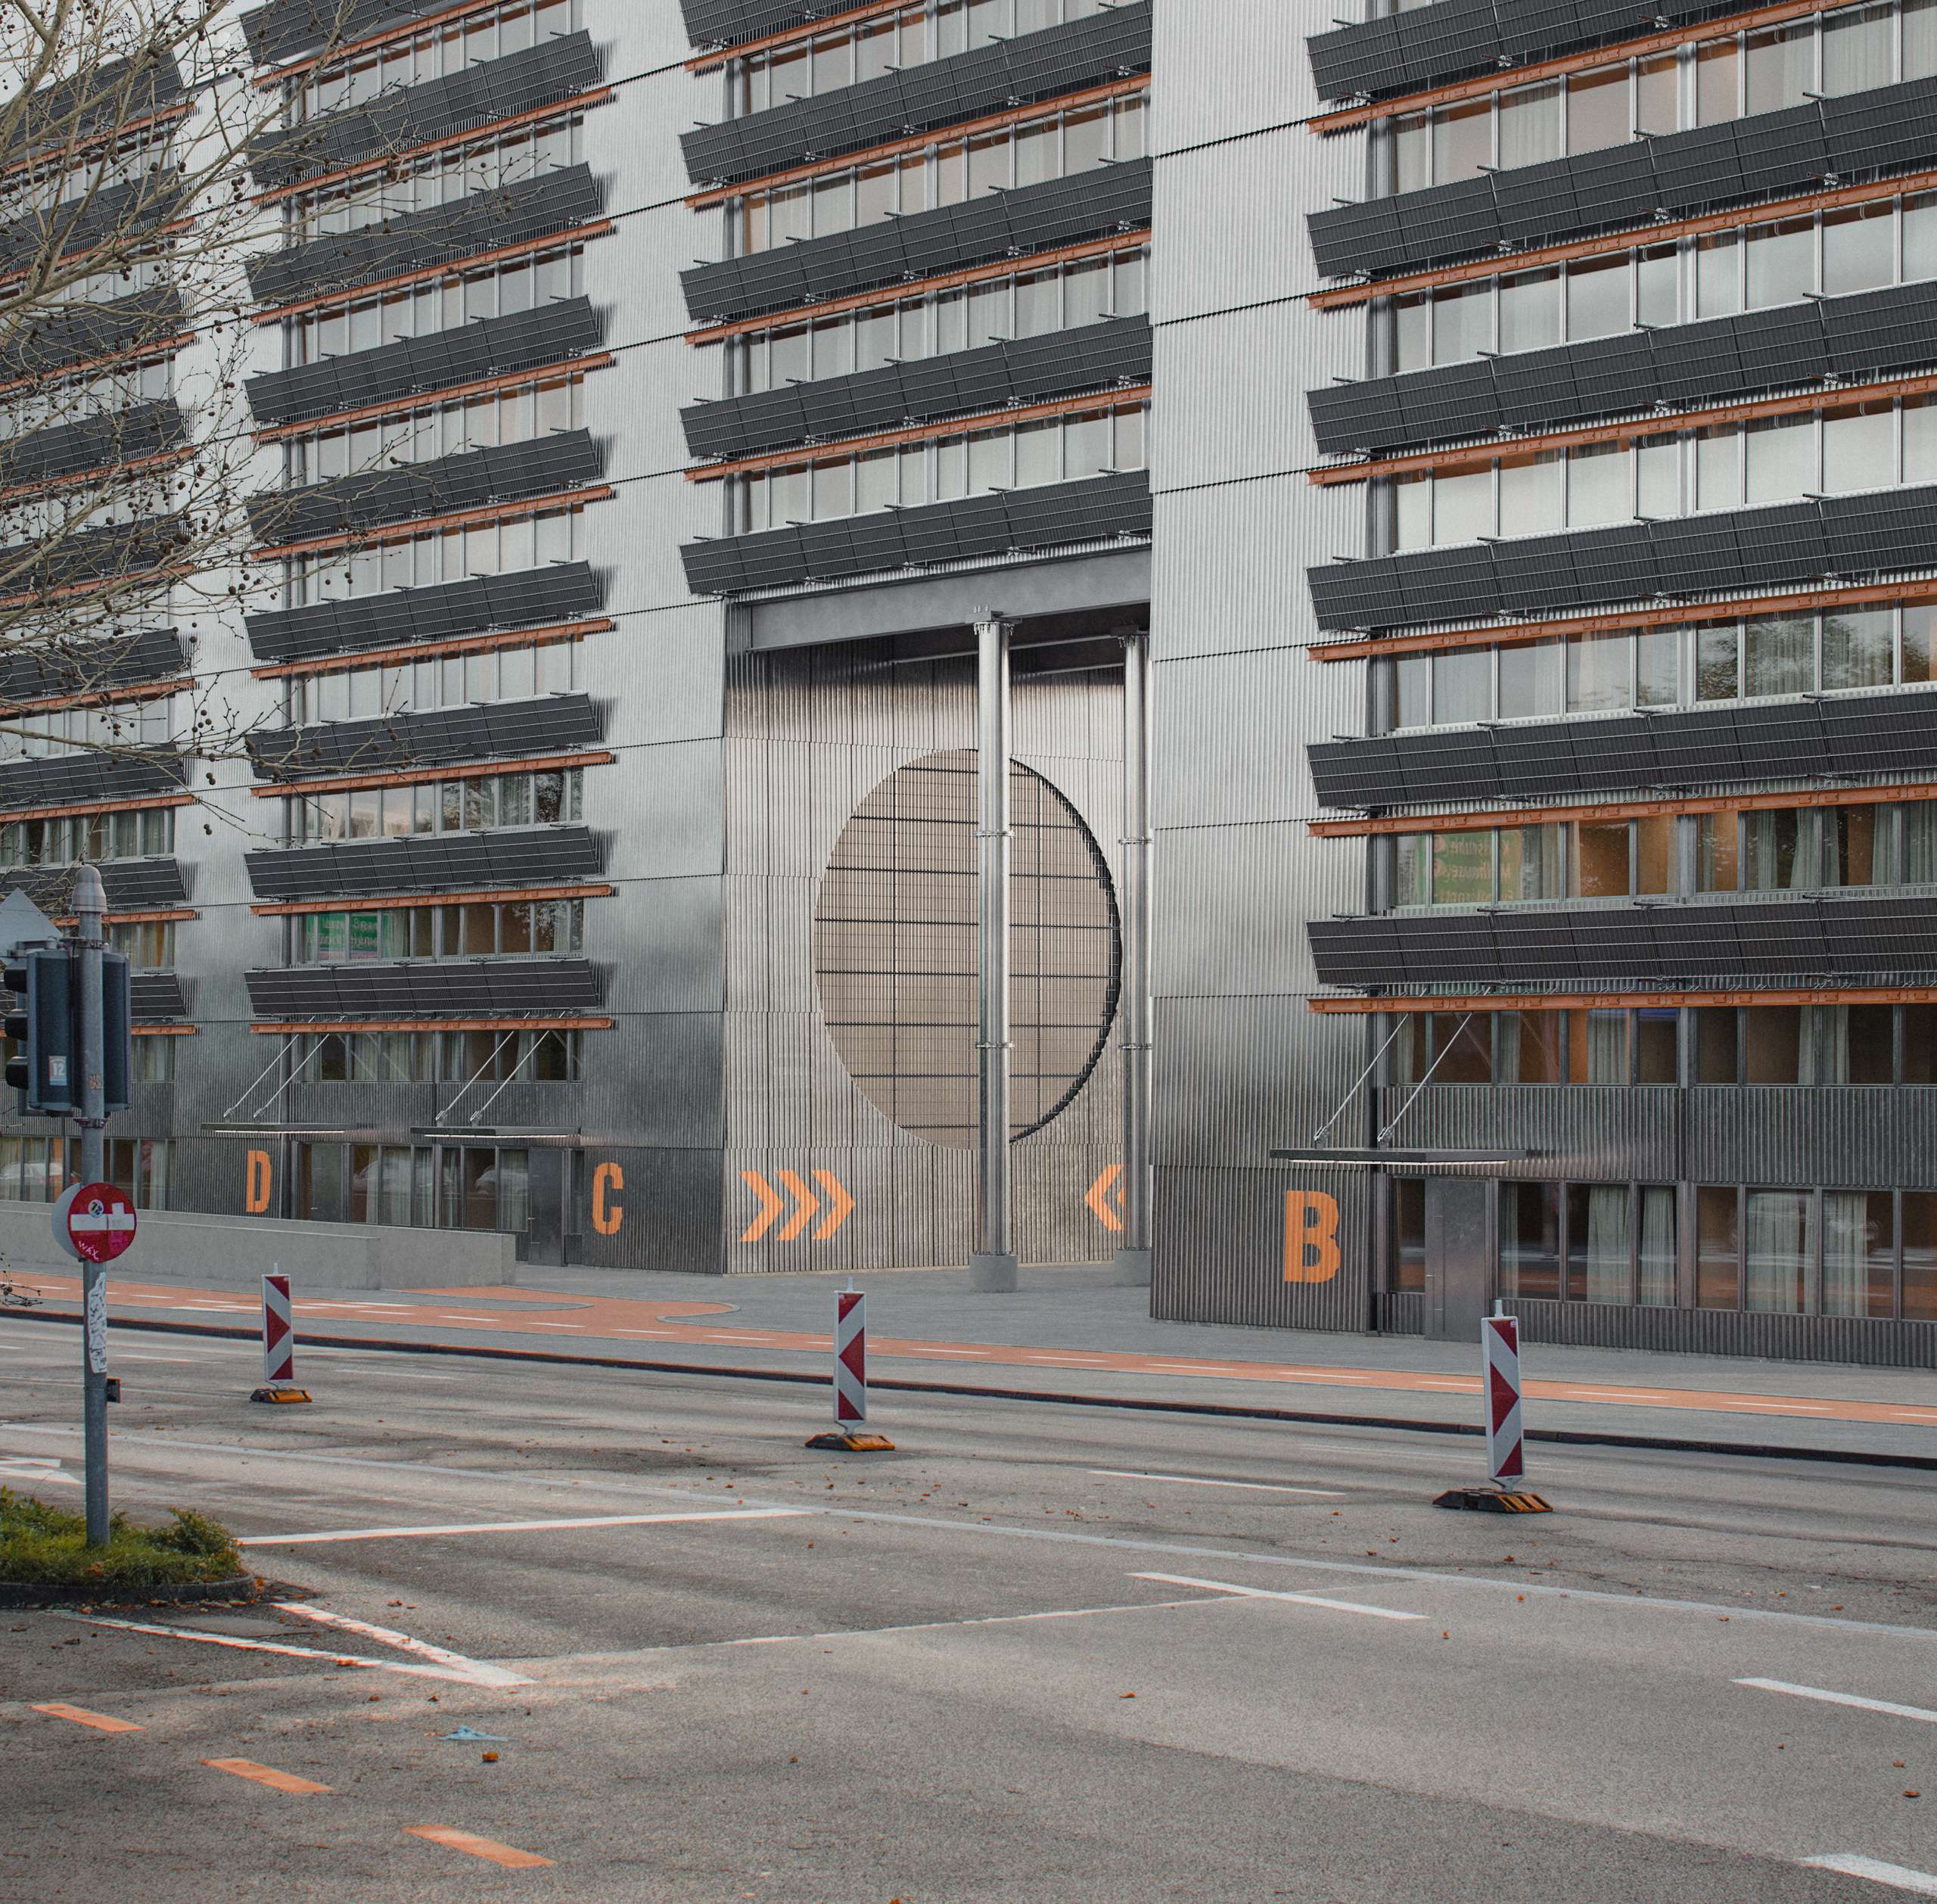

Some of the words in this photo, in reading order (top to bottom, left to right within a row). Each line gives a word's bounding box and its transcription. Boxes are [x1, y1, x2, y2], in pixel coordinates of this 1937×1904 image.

[246, 1150, 271, 1212] D
[593, 1162, 623, 1234] C
[1285, 1190, 1341, 1283] B
